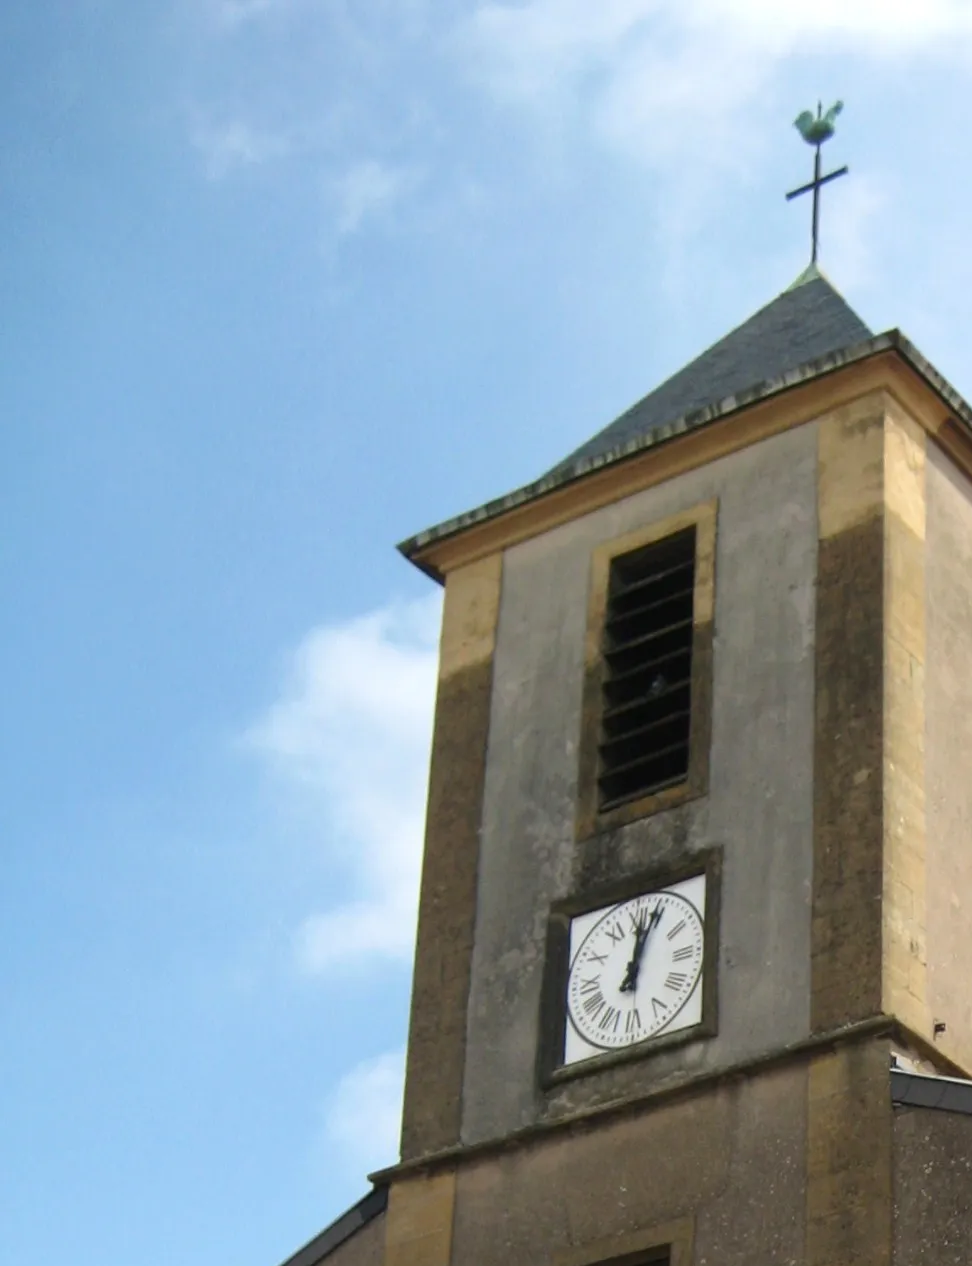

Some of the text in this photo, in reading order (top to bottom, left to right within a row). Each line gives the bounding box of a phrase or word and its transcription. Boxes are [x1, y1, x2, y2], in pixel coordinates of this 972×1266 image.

[587, 950, 609, 966] X
[672, 945, 694, 963] III
[650, 997, 669, 1019] V
